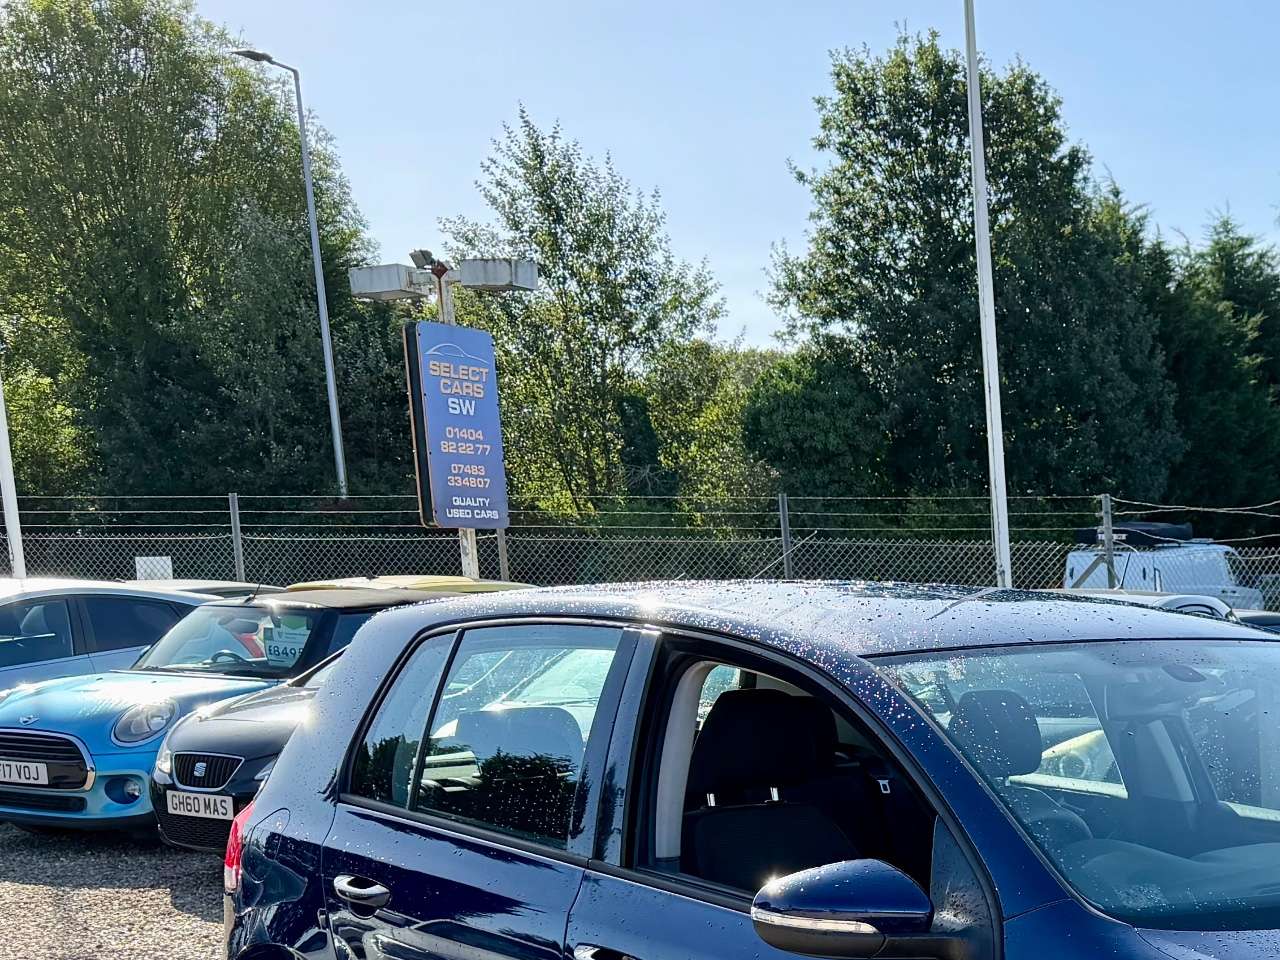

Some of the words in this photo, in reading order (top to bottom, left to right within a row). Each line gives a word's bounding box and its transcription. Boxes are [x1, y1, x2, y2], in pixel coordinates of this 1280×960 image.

[430, 361, 489, 382] SELECT
[441, 378, 485, 398] CARS
[447, 398, 476, 416] SW
[446, 427, 484, 440] 01404
[447, 476, 491, 488] 334807
[452, 496, 490, 507] QUALITY
[446, 508, 472, 518] USED
[474, 509, 499, 520] CARS
[171, 793, 200, 813] GH60
[203, 796, 228, 816] MAS
